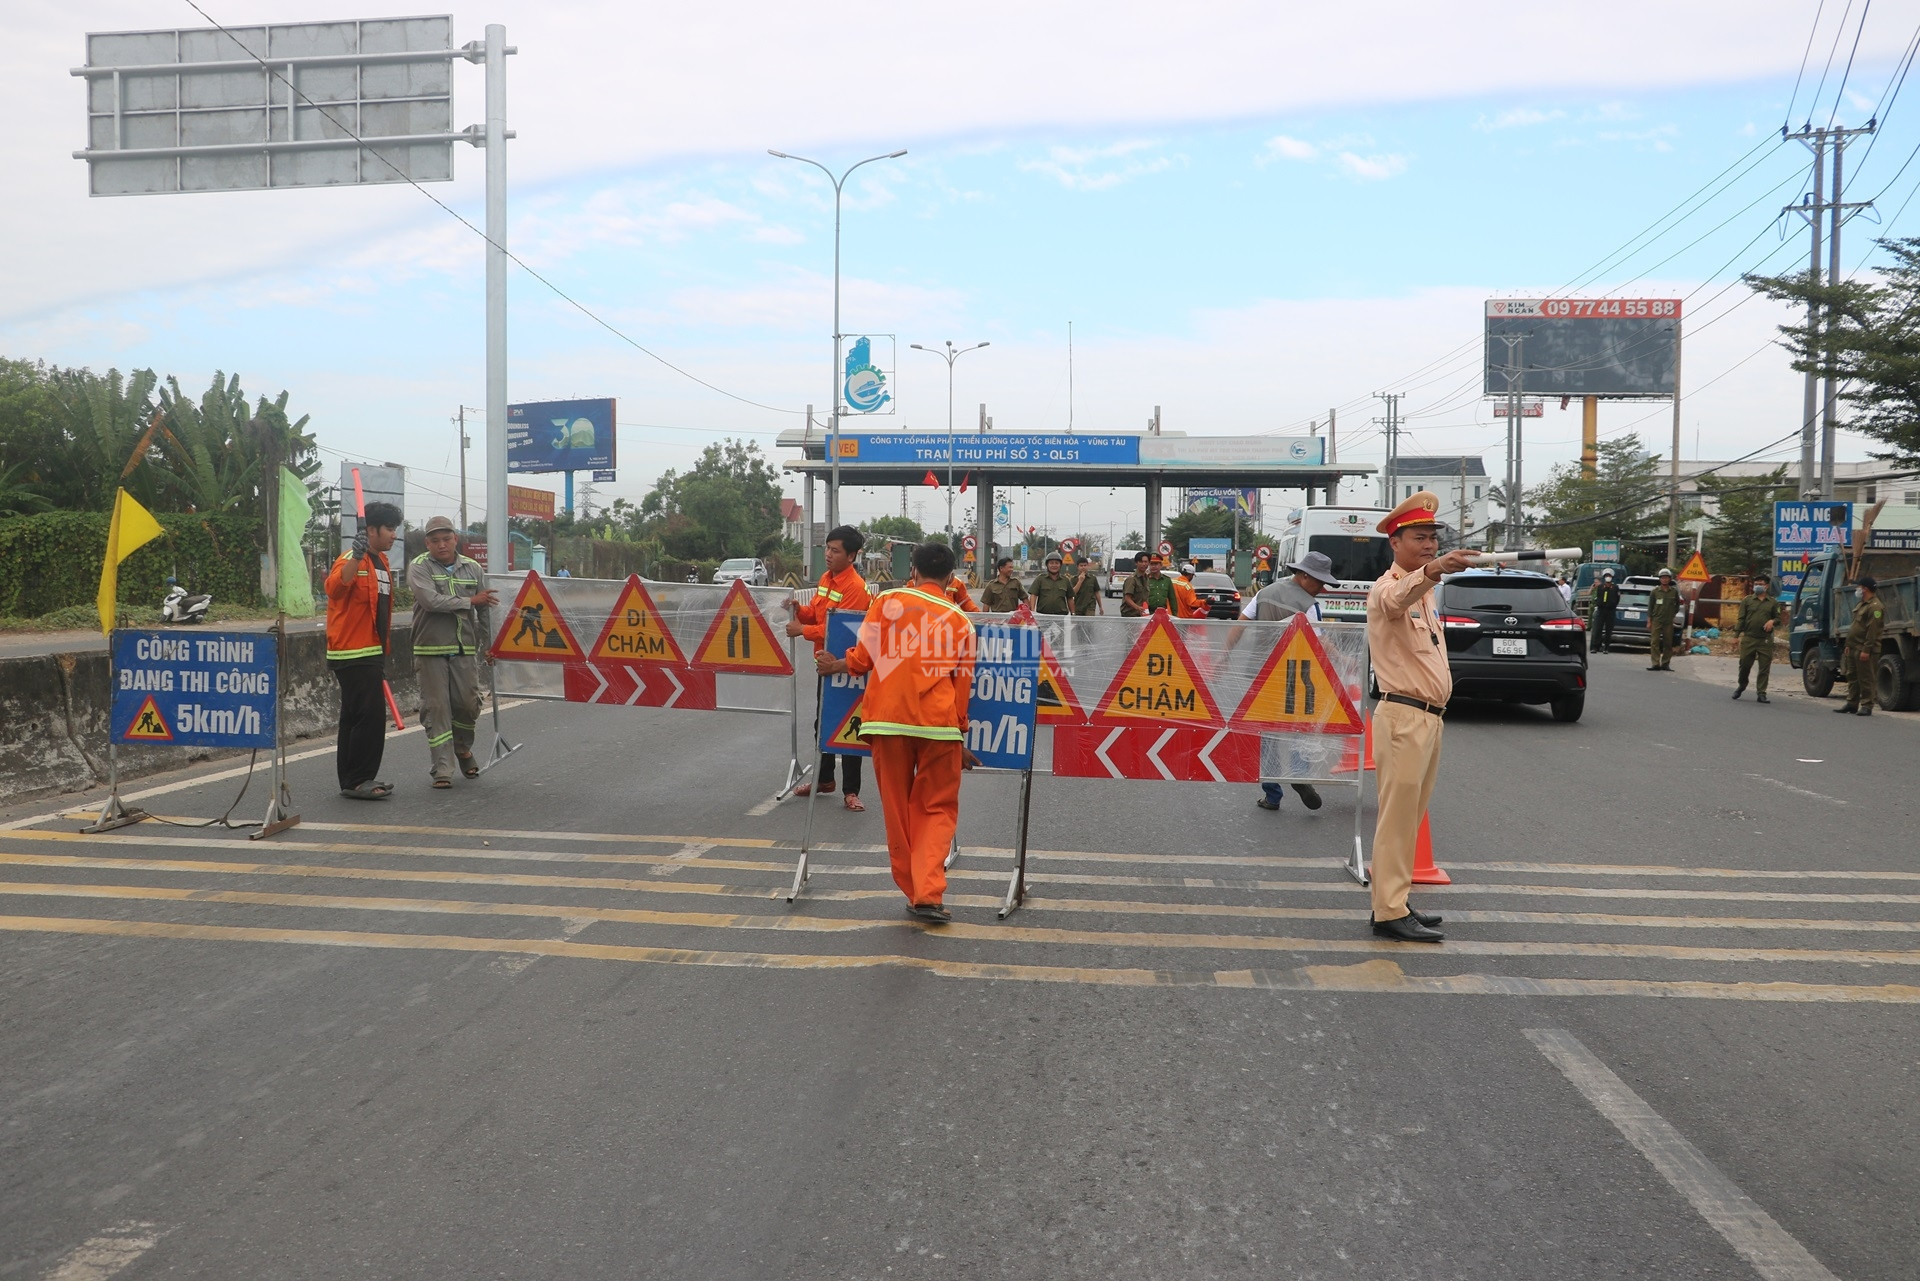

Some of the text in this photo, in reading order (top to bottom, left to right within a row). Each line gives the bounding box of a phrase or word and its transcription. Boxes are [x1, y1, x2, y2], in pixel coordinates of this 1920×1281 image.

[1547, 301, 1675, 316] 09 77 44 55 88
[870, 436, 891, 444] CÔNG
[1010, 437, 1025, 445] CAO
[1045, 437, 1062, 445] BIÊN
[916, 449, 950, 461] TRẠM
[956, 450, 982, 460] THU
[986, 446, 1007, 460] PHÍ
[1010, 446, 1028, 460] SỐ
[1033, 450, 1040, 460] 3
[1050, 450, 1079, 461] QL51
[1781, 505, 1809, 521] NHÀ
[1778, 523, 1812, 543] TÂN
[1193, 542, 1228, 550] vinaphone
[626, 609, 646, 627] ĐI
[137, 635, 254, 663] CÔNG TRÌNH
[608, 632, 665, 658] CHẬM
[1147, 653, 1172, 676] ĐI
[120, 668, 269, 694] ĐANG THI CÔNG
[1118, 682, 1195, 716] CHẬM
[177, 704, 260, 735] 5km/h
[964, 714, 1028, 755] m/h
